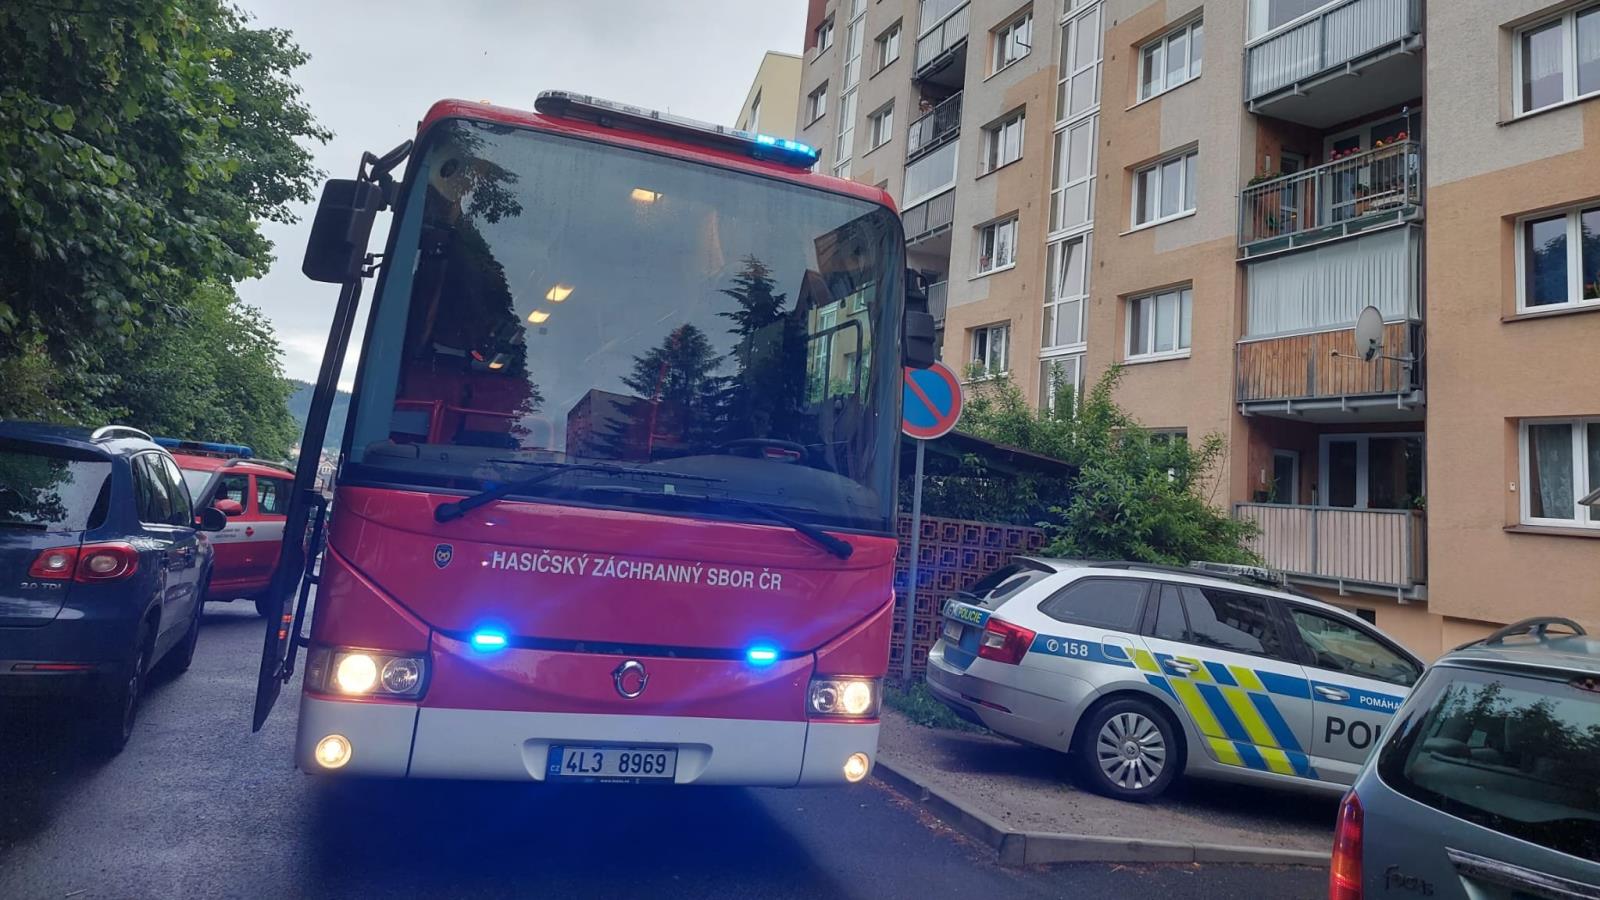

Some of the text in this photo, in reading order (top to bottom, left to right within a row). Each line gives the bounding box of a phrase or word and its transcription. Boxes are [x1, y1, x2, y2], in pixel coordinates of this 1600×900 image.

[491, 549, 782, 591] HASIČSKÝ ZÁCHRANNÝ SBOR ČR
[41, 582, 62, 590] TDI
[959, 606, 983, 624] POLICIE
[1062, 642, 1089, 657] 158
[550, 764, 561, 773] CZ
[565, 751, 667, 774] 4L3 8969
